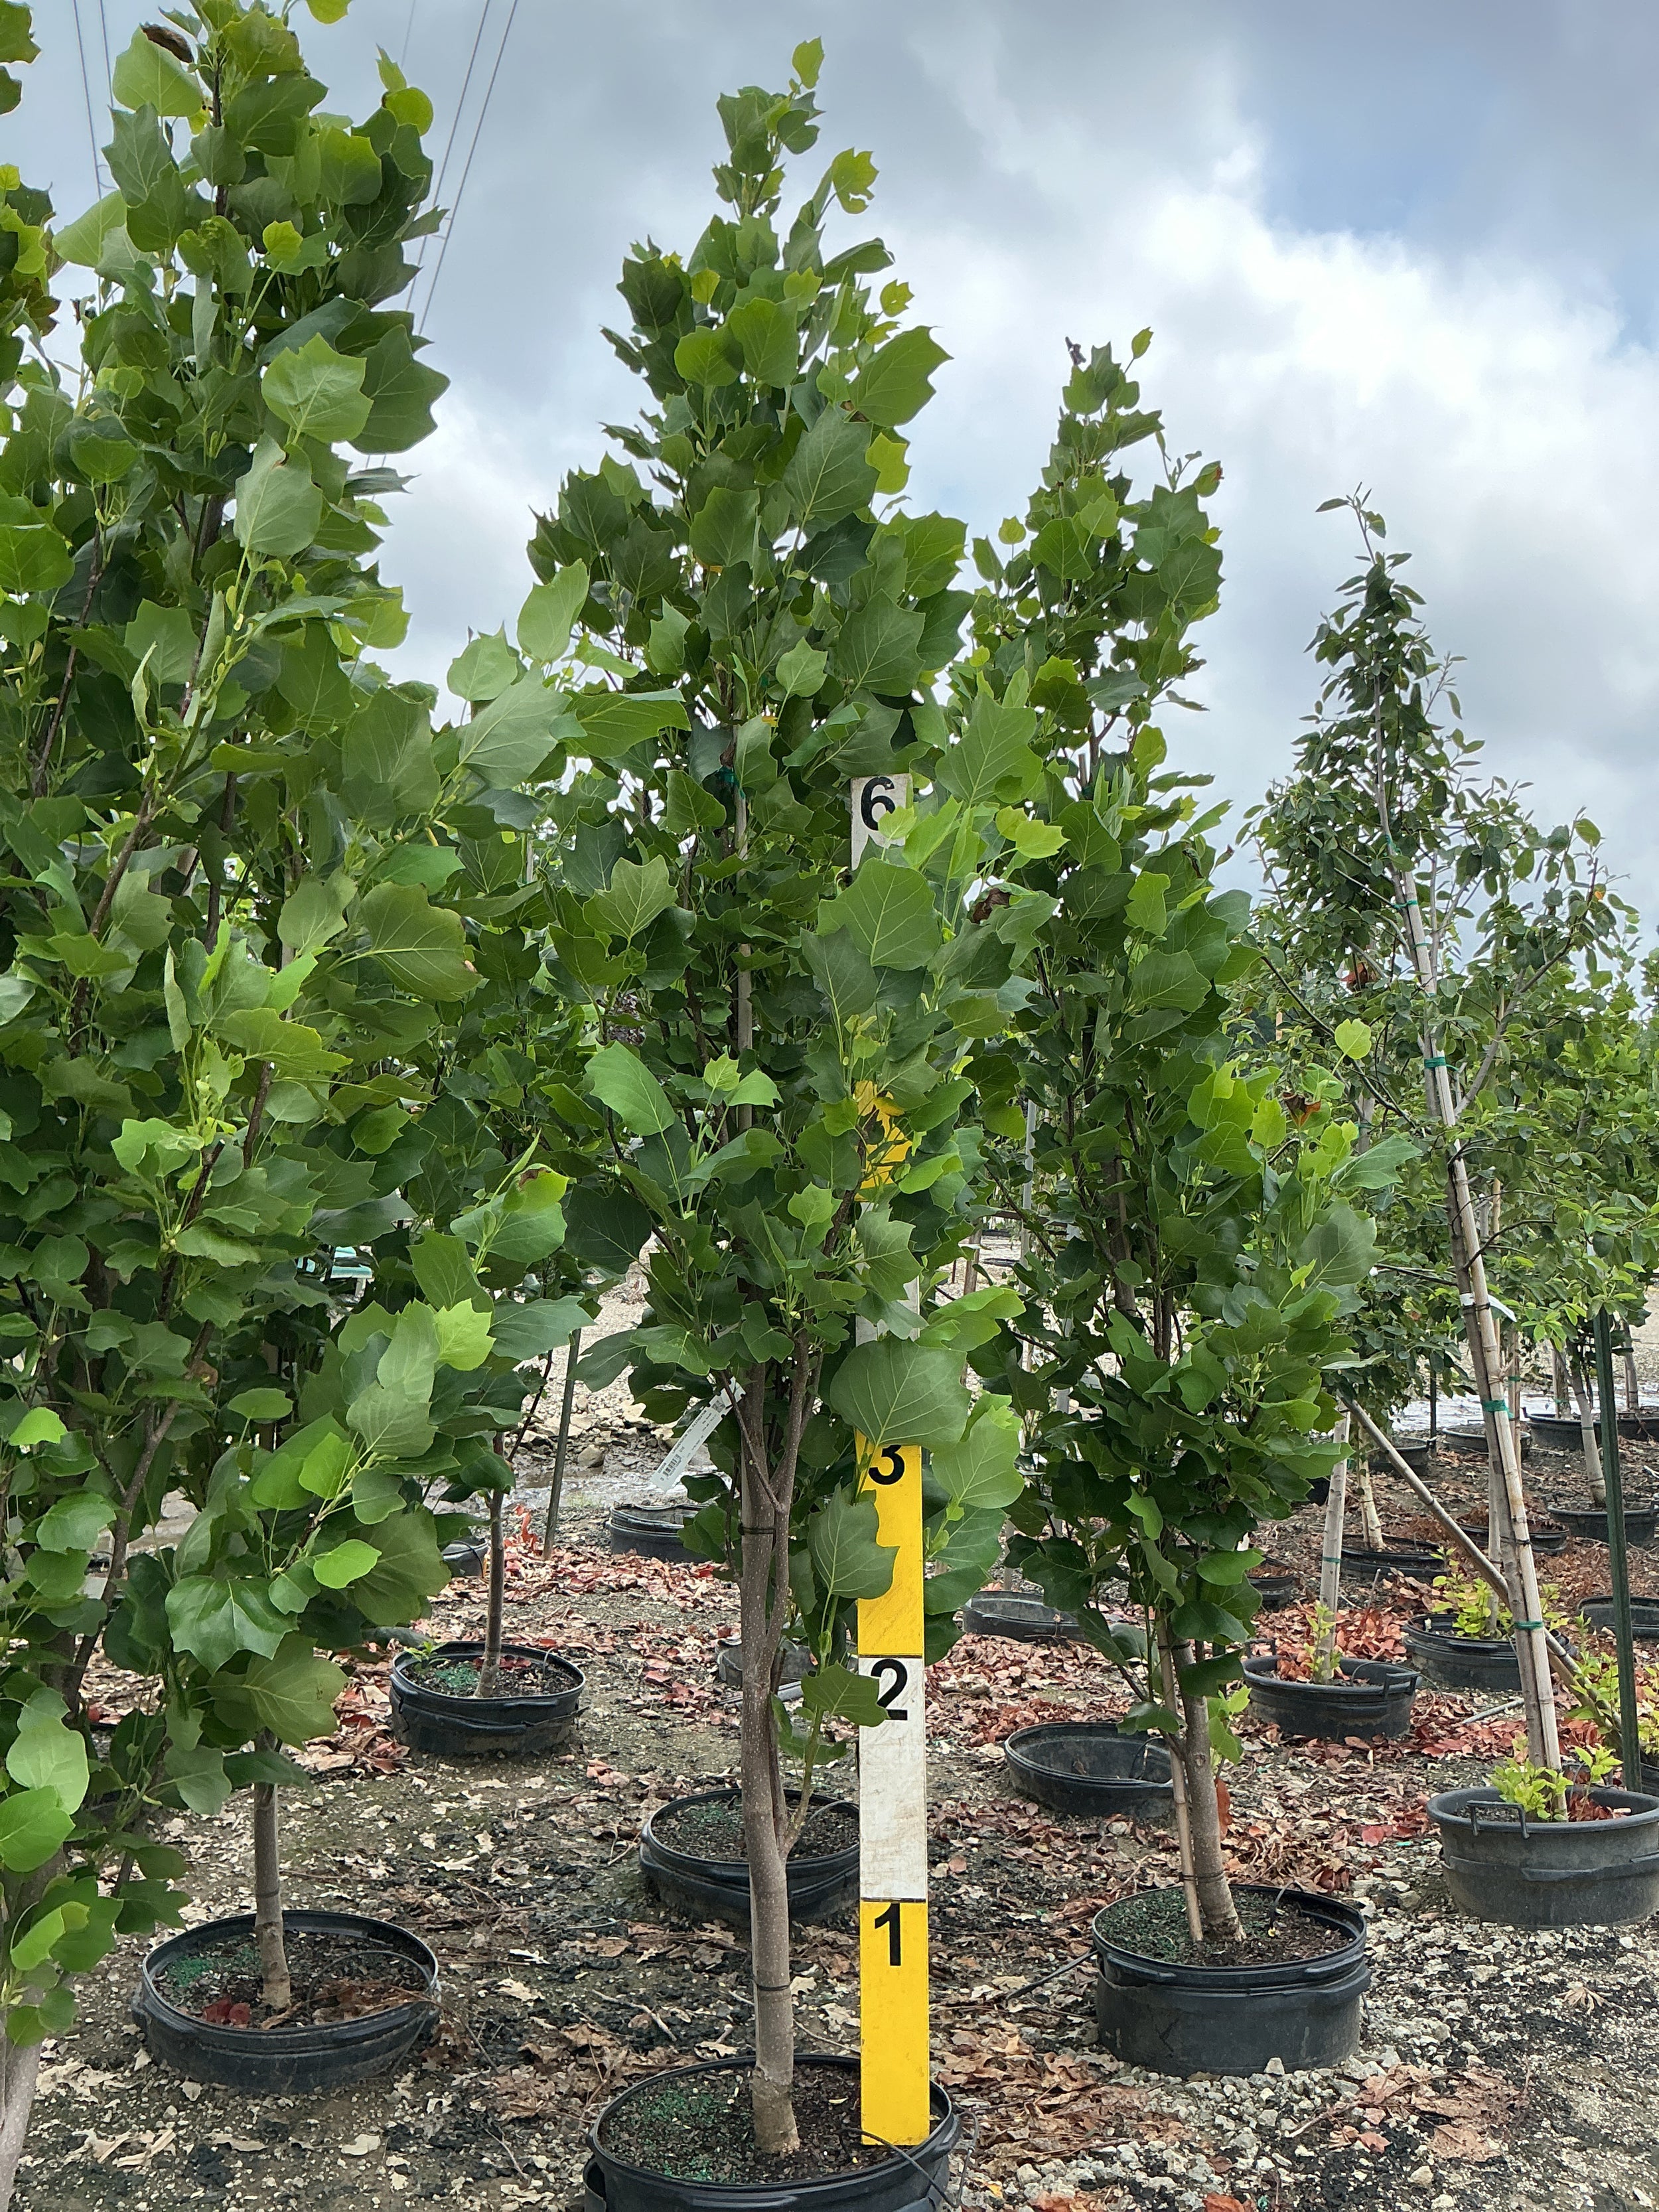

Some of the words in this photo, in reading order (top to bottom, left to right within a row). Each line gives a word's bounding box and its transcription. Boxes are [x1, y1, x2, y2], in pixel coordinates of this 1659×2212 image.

[861, 776, 895, 831] 6
[868, 1444, 905, 1485] 3
[871, 1659, 908, 1721] 2
[874, 1902, 901, 1966] 1
